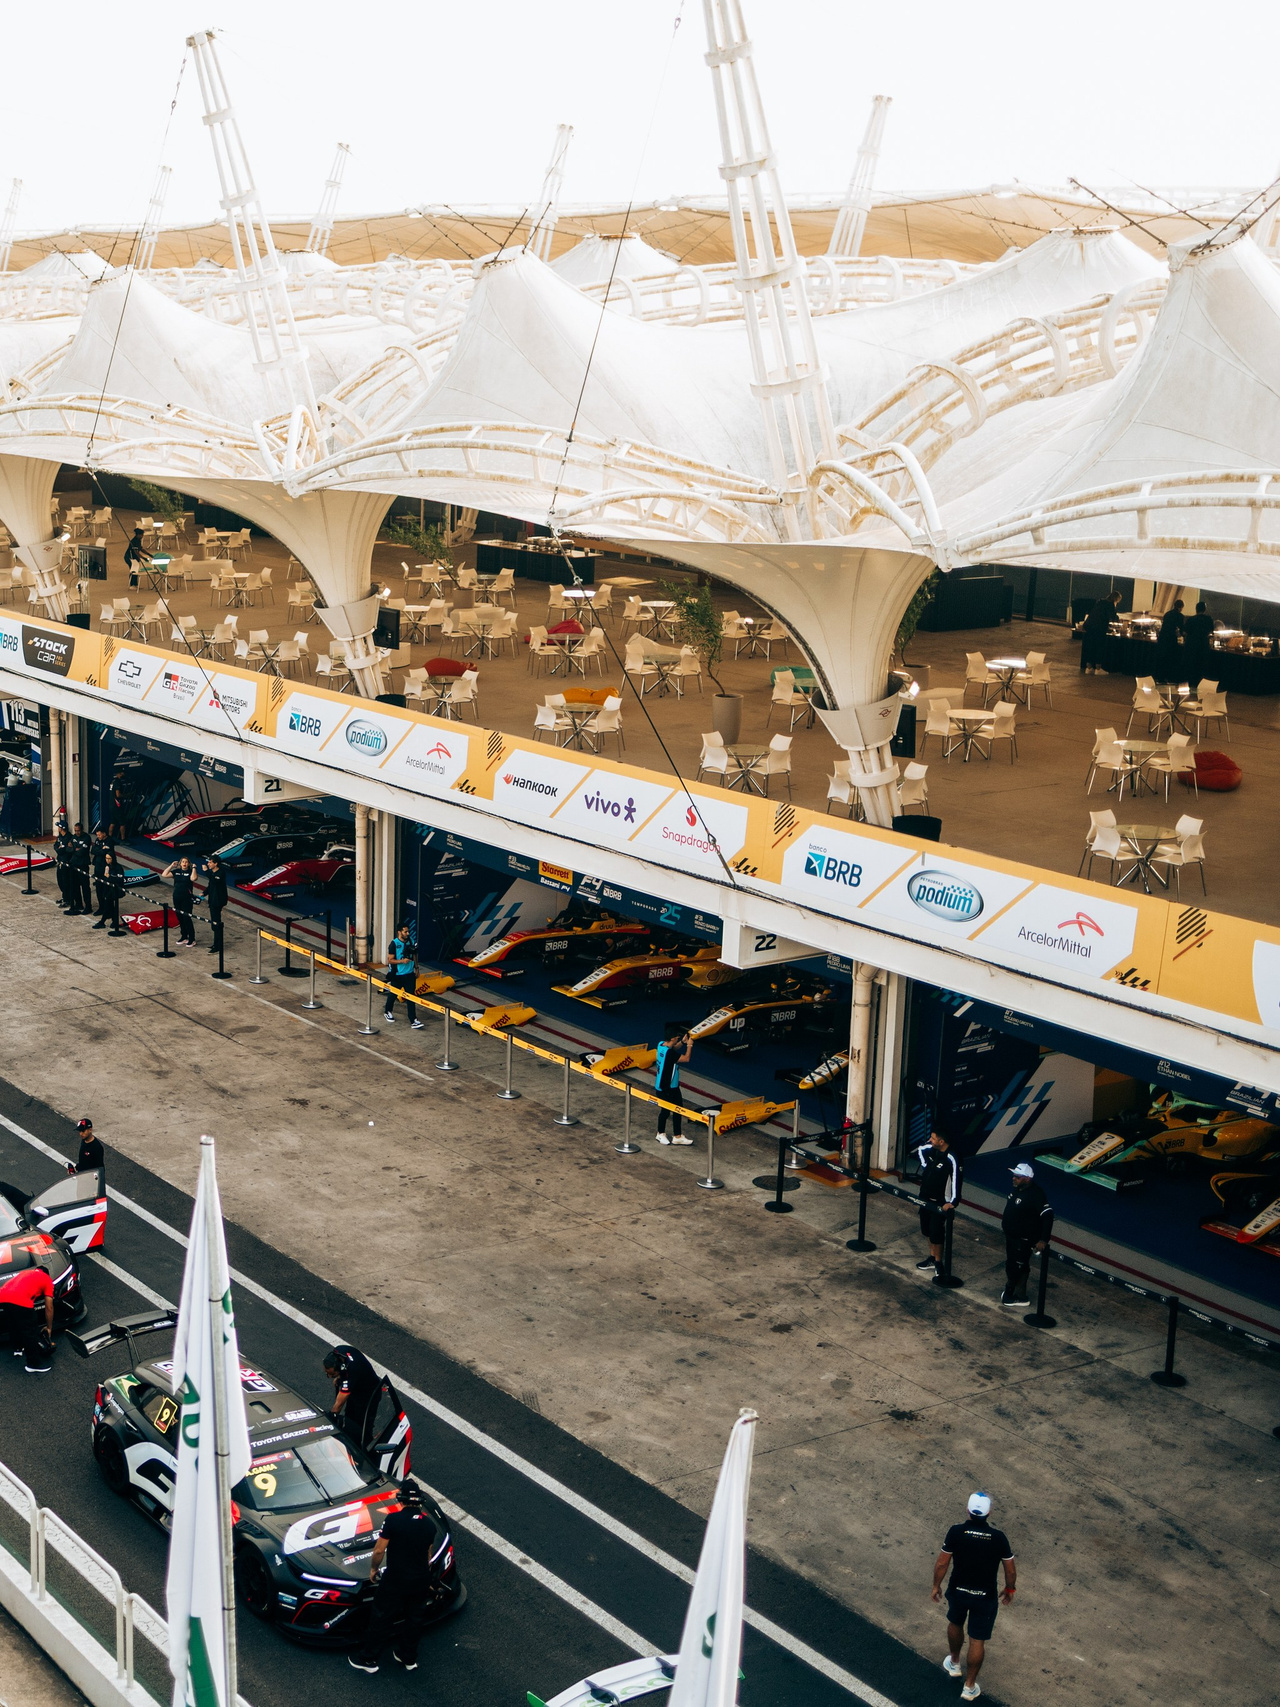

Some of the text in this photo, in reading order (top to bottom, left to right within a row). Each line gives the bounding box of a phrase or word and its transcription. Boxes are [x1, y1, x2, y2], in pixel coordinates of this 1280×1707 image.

[2, 634, 19, 652] BRB
[32, 637, 68, 655] STOCK
[117, 678, 141, 690] CHEVROLET
[163, 680, 178, 691] GR
[180, 676, 198, 686] TOYOTA
[178, 686, 194, 697] Racing
[222, 694, 248, 708] MITSUBISHI
[10, 700, 25, 724] 113
[223, 703, 241, 714] MOTORS
[300, 716, 321, 737] BRB
[350, 731, 382, 750] podium
[201, 755, 215, 767] F4
[406, 755, 446, 776] ArcelorMittal
[264, 779, 282, 793] 21
[584, 791, 621, 817] vivo
[809, 843, 827, 854] banco
[542, 861, 569, 879] Starrett
[824, 857, 863, 888] BRB
[540, 876, 560, 888] Bassani
[581, 875, 603, 890] F4
[920, 877, 944, 887] PETROBRAS
[609, 889, 622, 901] BRB
[916, 884, 972, 914] podium
[631, 901, 657, 911] TEMPORADA
[660, 902, 682, 925] 25
[553, 940, 569, 950] BRB
[754, 933, 777, 952] 22
[1017, 926, 1092, 959] ArcelorMittal
[657, 967, 673, 977] BRB
[779, 1010, 797, 1022] BRB
[1158, 1060, 1171, 1068] #12
[1157, 1065, 1175, 1076] ETHAN
[1174, 1070, 1192, 1081] NOBEL
[1230, 1090, 1265, 1104] BRAZILIAN
[1171, 1138, 1185, 1148] BRB
[161, 1407, 171, 1422] 9
[284, 1409, 317, 1421] BRASIL
[250, 1424, 335, 1448] TOYOTA GAZOO Racing
[253, 1473, 277, 1498] 9
[355, 1551, 374, 1561] TOYO
[303, 1588, 341, 1601] GR
